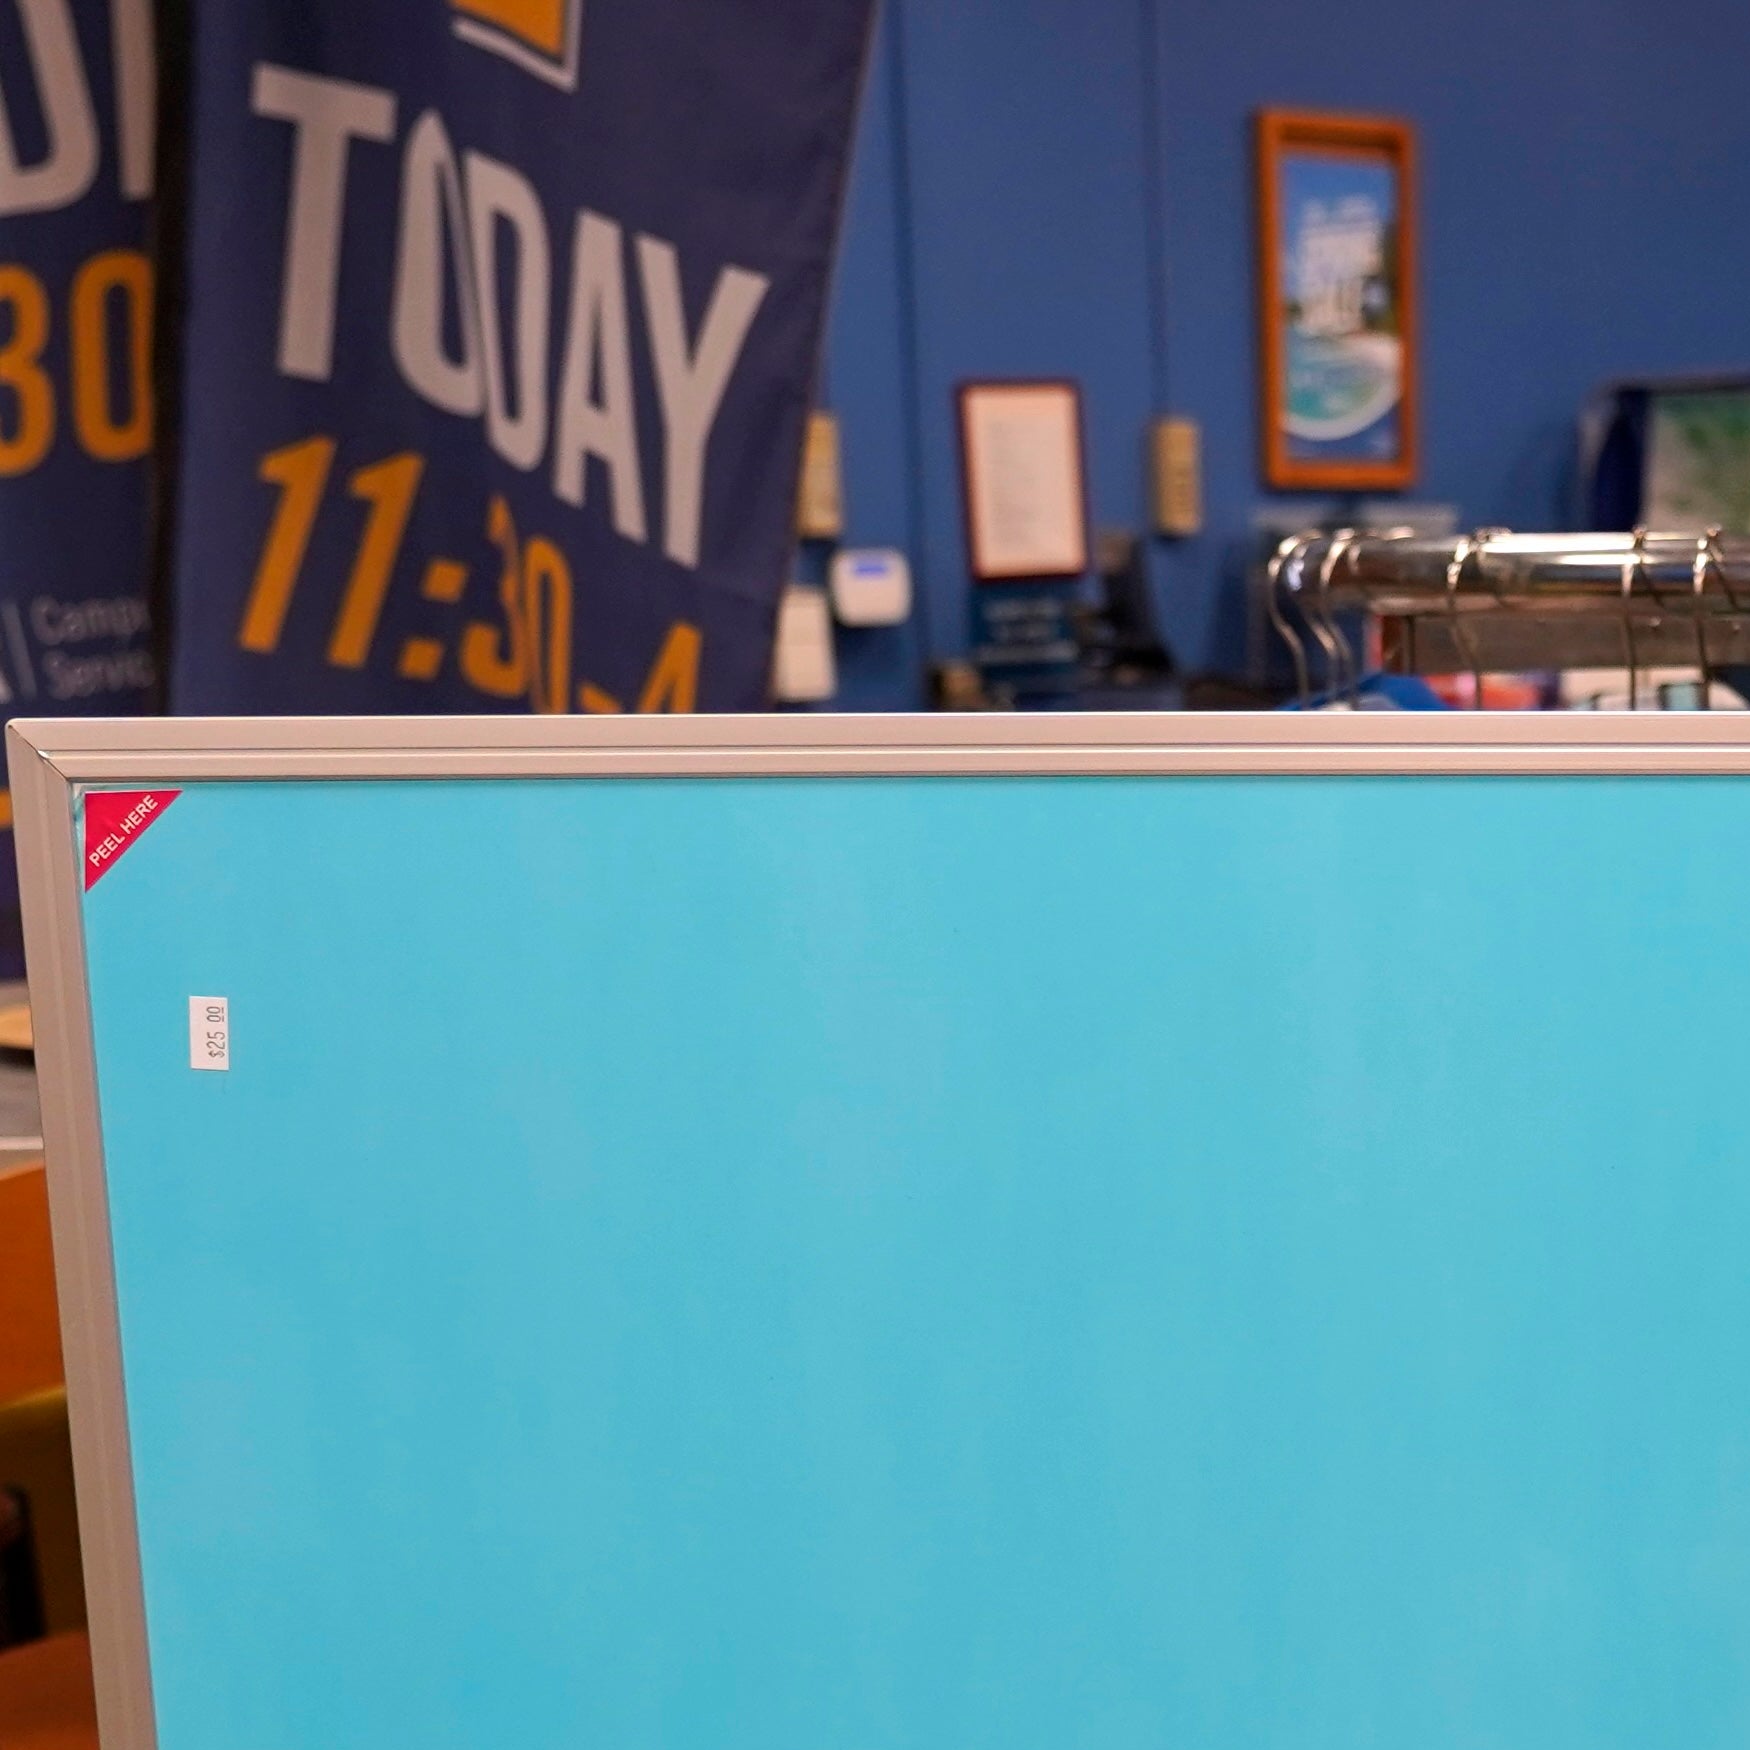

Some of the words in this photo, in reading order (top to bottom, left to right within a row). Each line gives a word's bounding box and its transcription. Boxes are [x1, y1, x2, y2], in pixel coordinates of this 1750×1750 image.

[251, 62, 771, 569] TODAY
[89, 833, 125, 867] PEEL
[119, 794, 158, 835] HERE
[206, 1031, 225, 1058] $25
